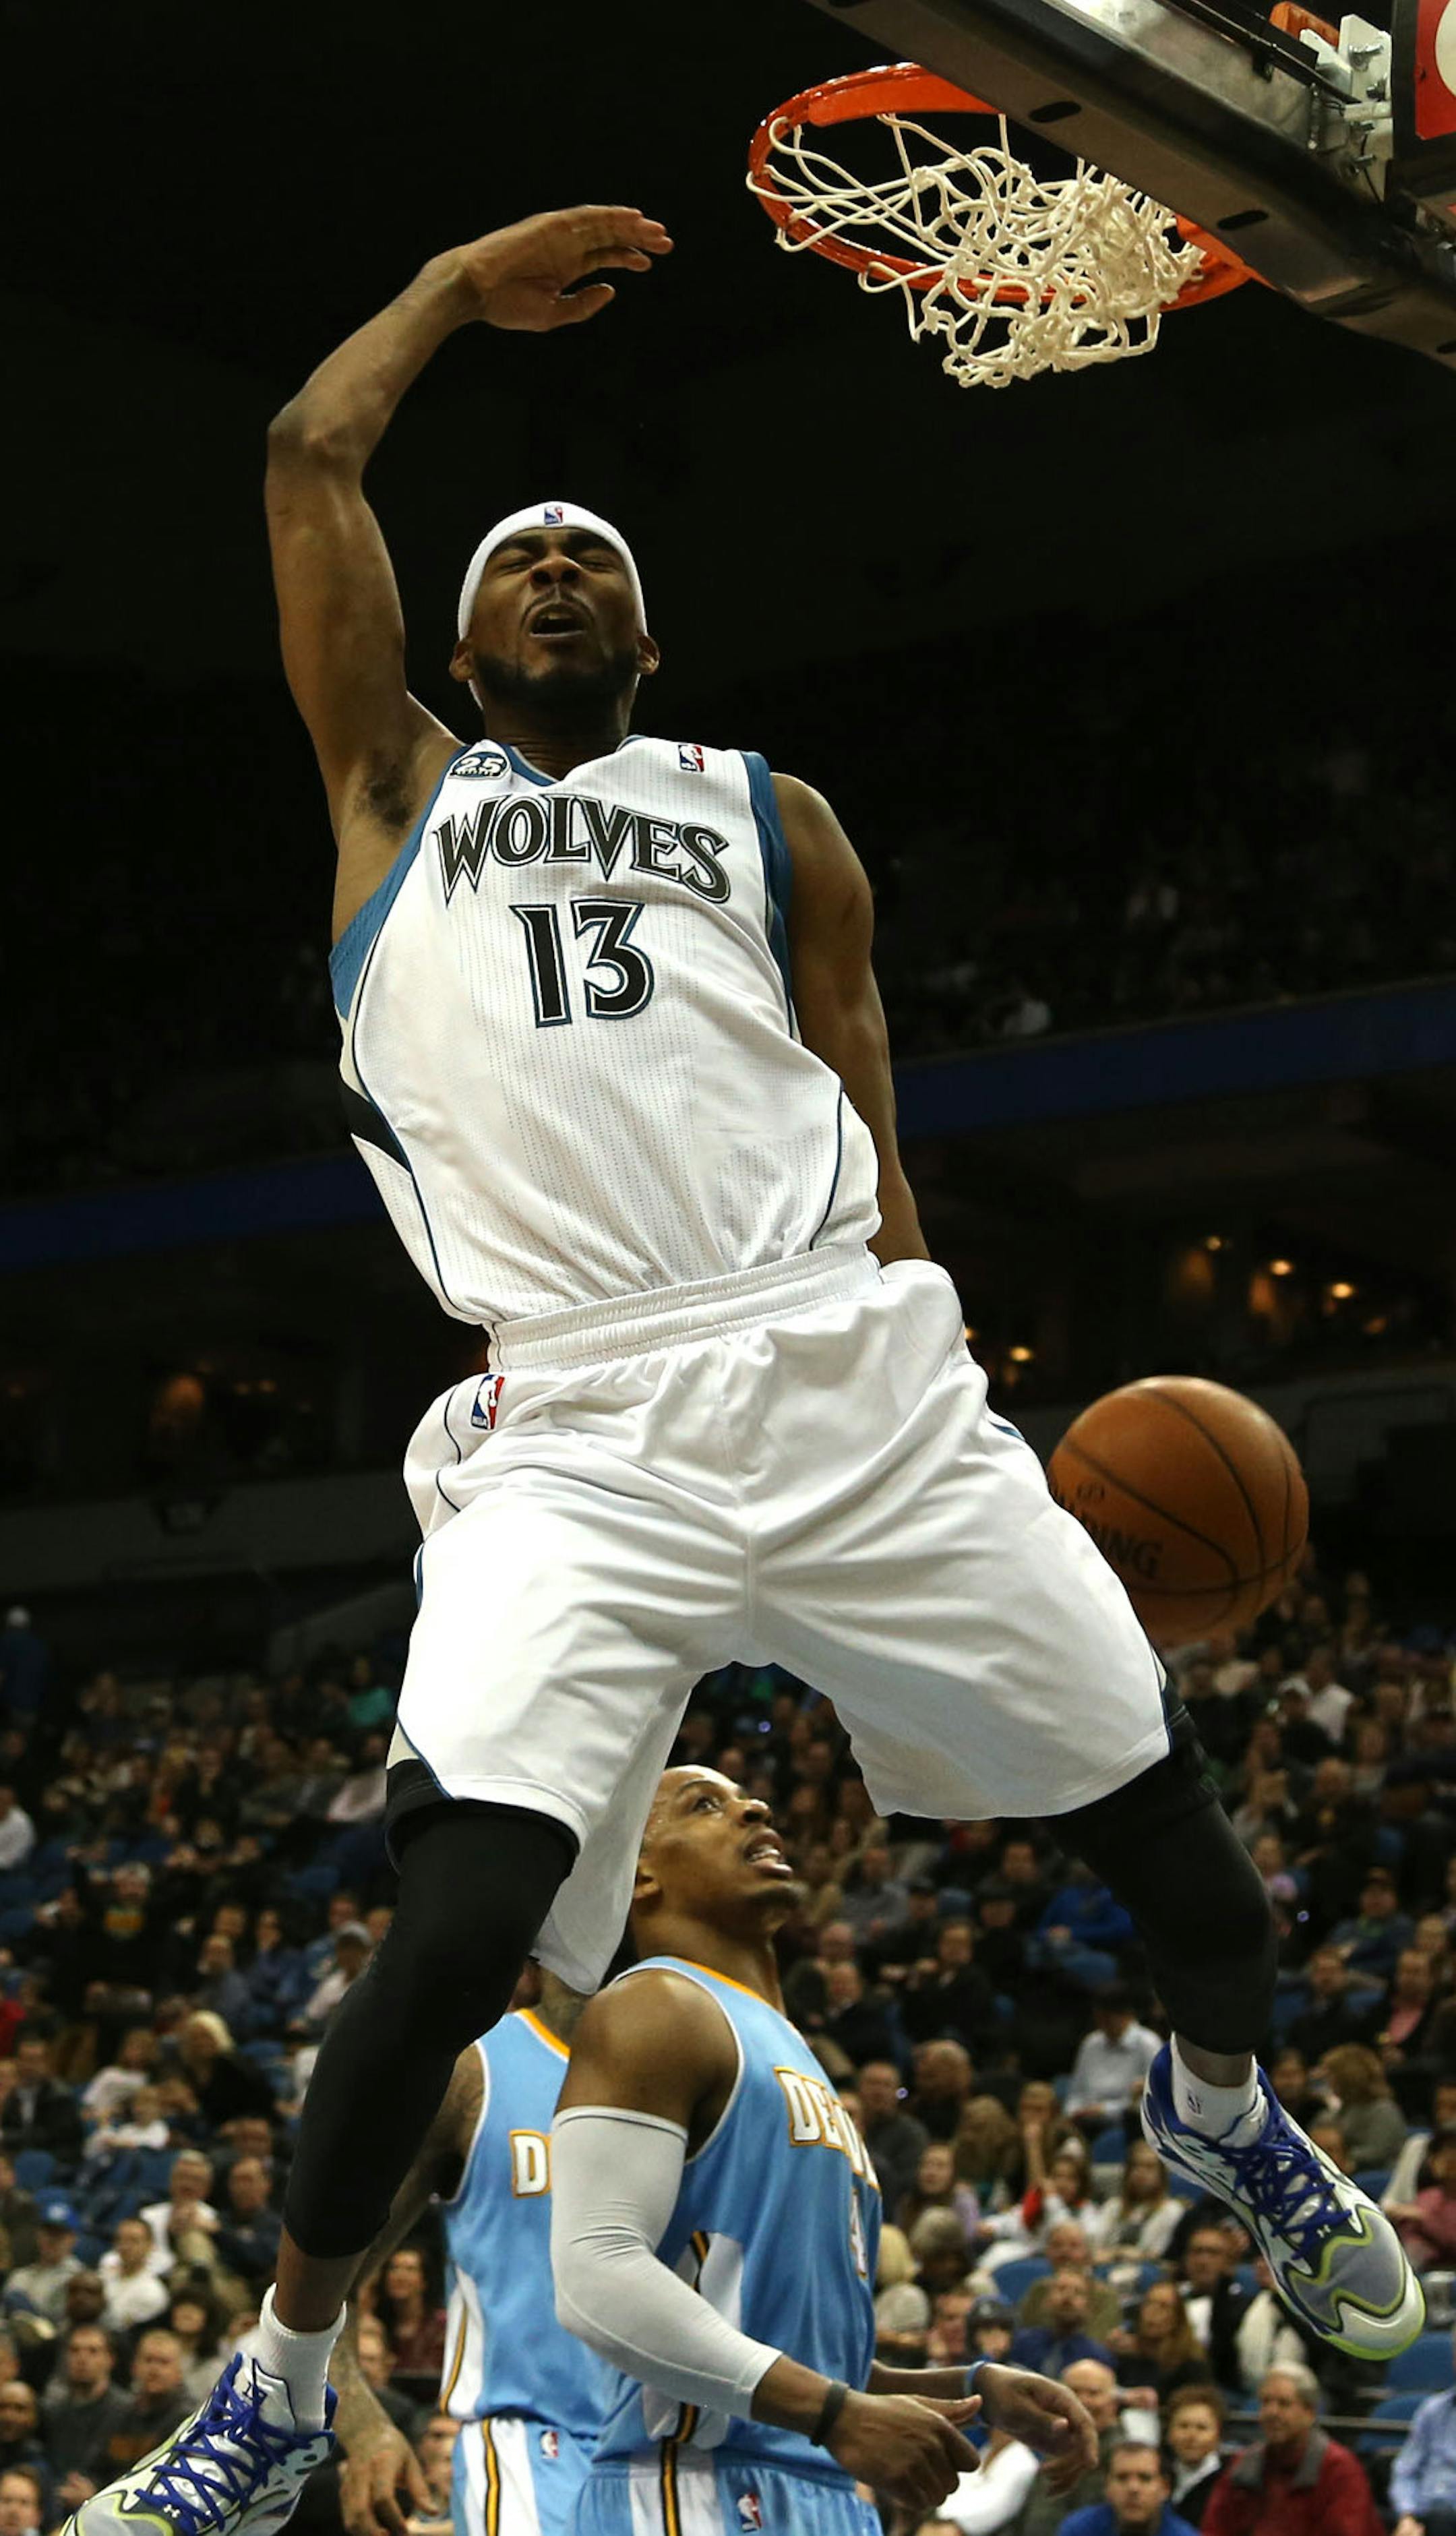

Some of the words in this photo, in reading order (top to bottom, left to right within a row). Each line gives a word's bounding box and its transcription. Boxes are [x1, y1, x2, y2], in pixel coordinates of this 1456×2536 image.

[460, 756, 504, 775] 25
[432, 793, 731, 908] WOLVES
[509, 897, 655, 1029] 13
